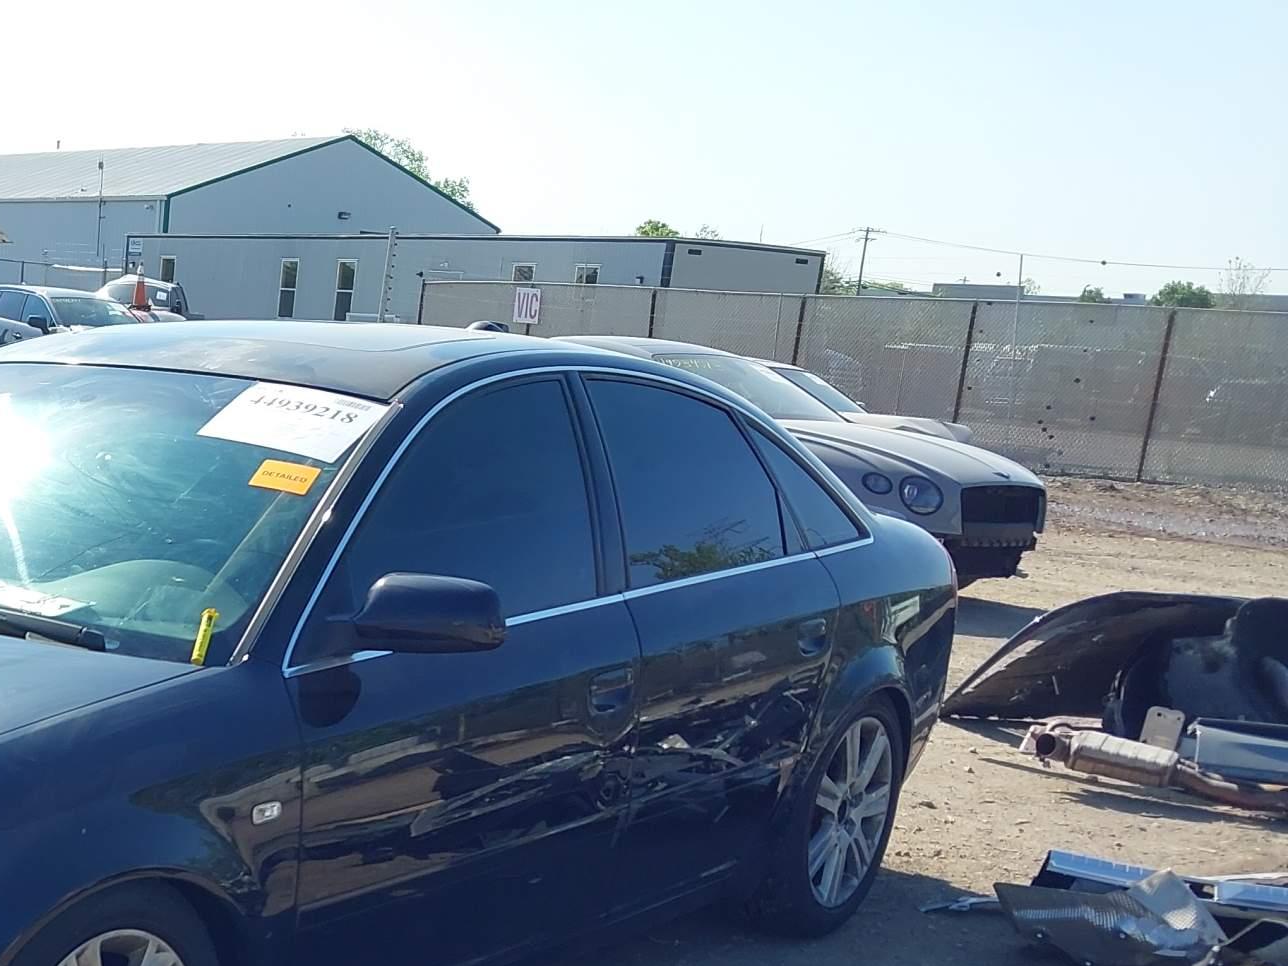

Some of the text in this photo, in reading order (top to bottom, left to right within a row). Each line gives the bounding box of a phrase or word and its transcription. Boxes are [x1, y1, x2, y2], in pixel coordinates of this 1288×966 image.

[517, 291, 539, 320] VIC
[248, 394, 359, 424] 44939218
[261, 470, 309, 483] DETAILED
